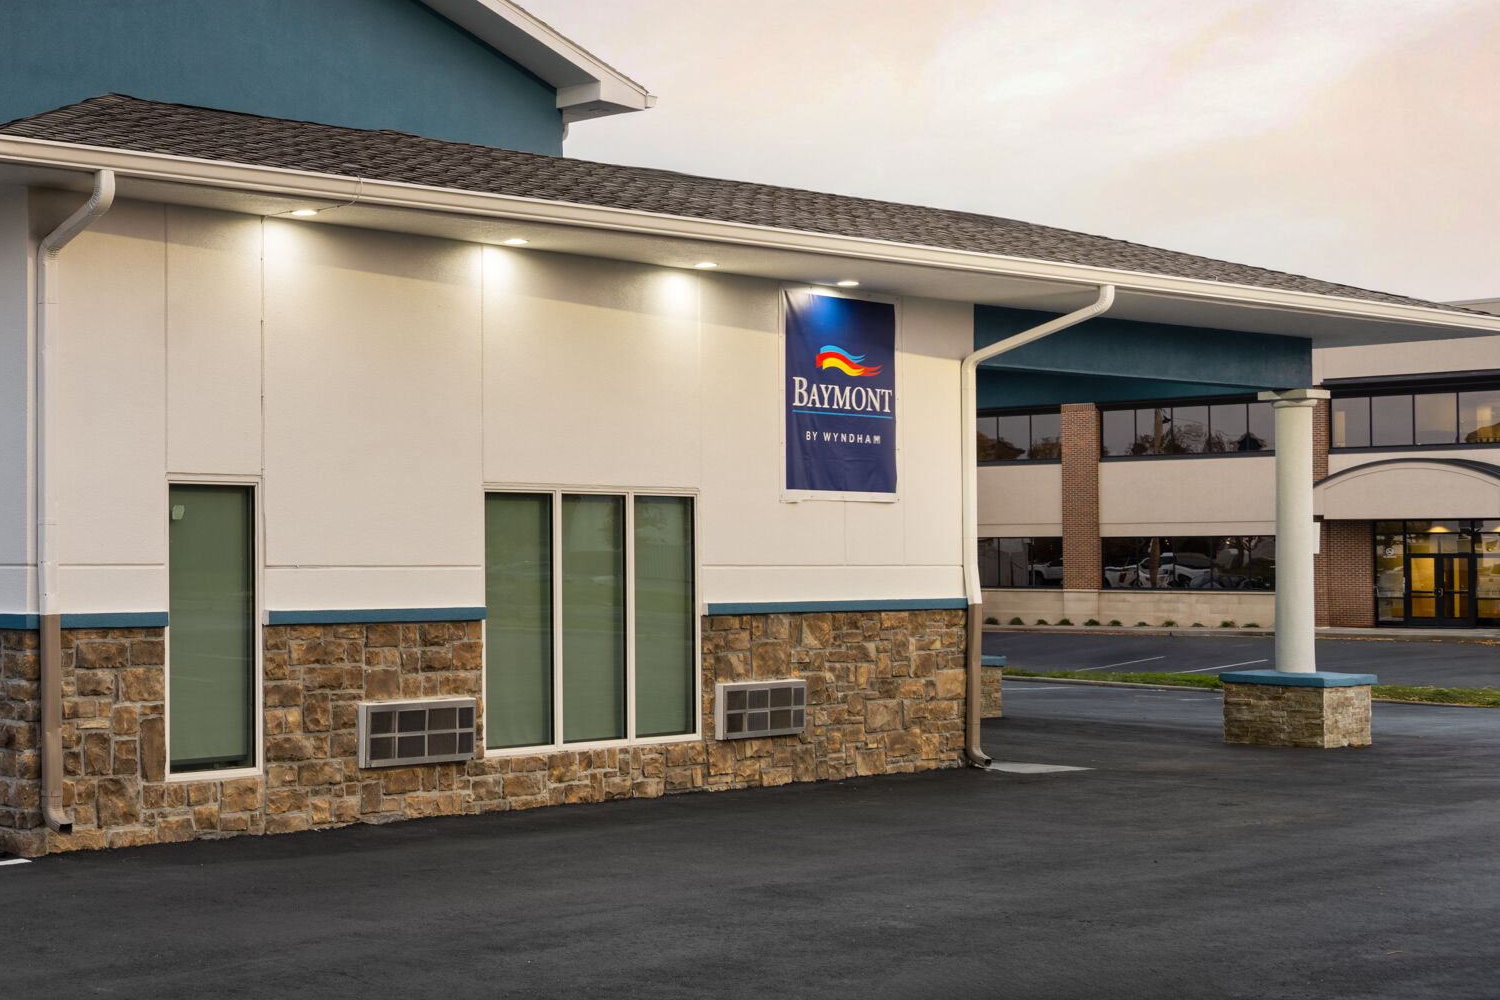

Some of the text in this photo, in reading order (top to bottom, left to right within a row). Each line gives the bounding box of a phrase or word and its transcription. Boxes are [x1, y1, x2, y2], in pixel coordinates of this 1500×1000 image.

[792, 376, 893, 413] BAYMONT
[805, 431, 881, 444] BY WYNDHAM
